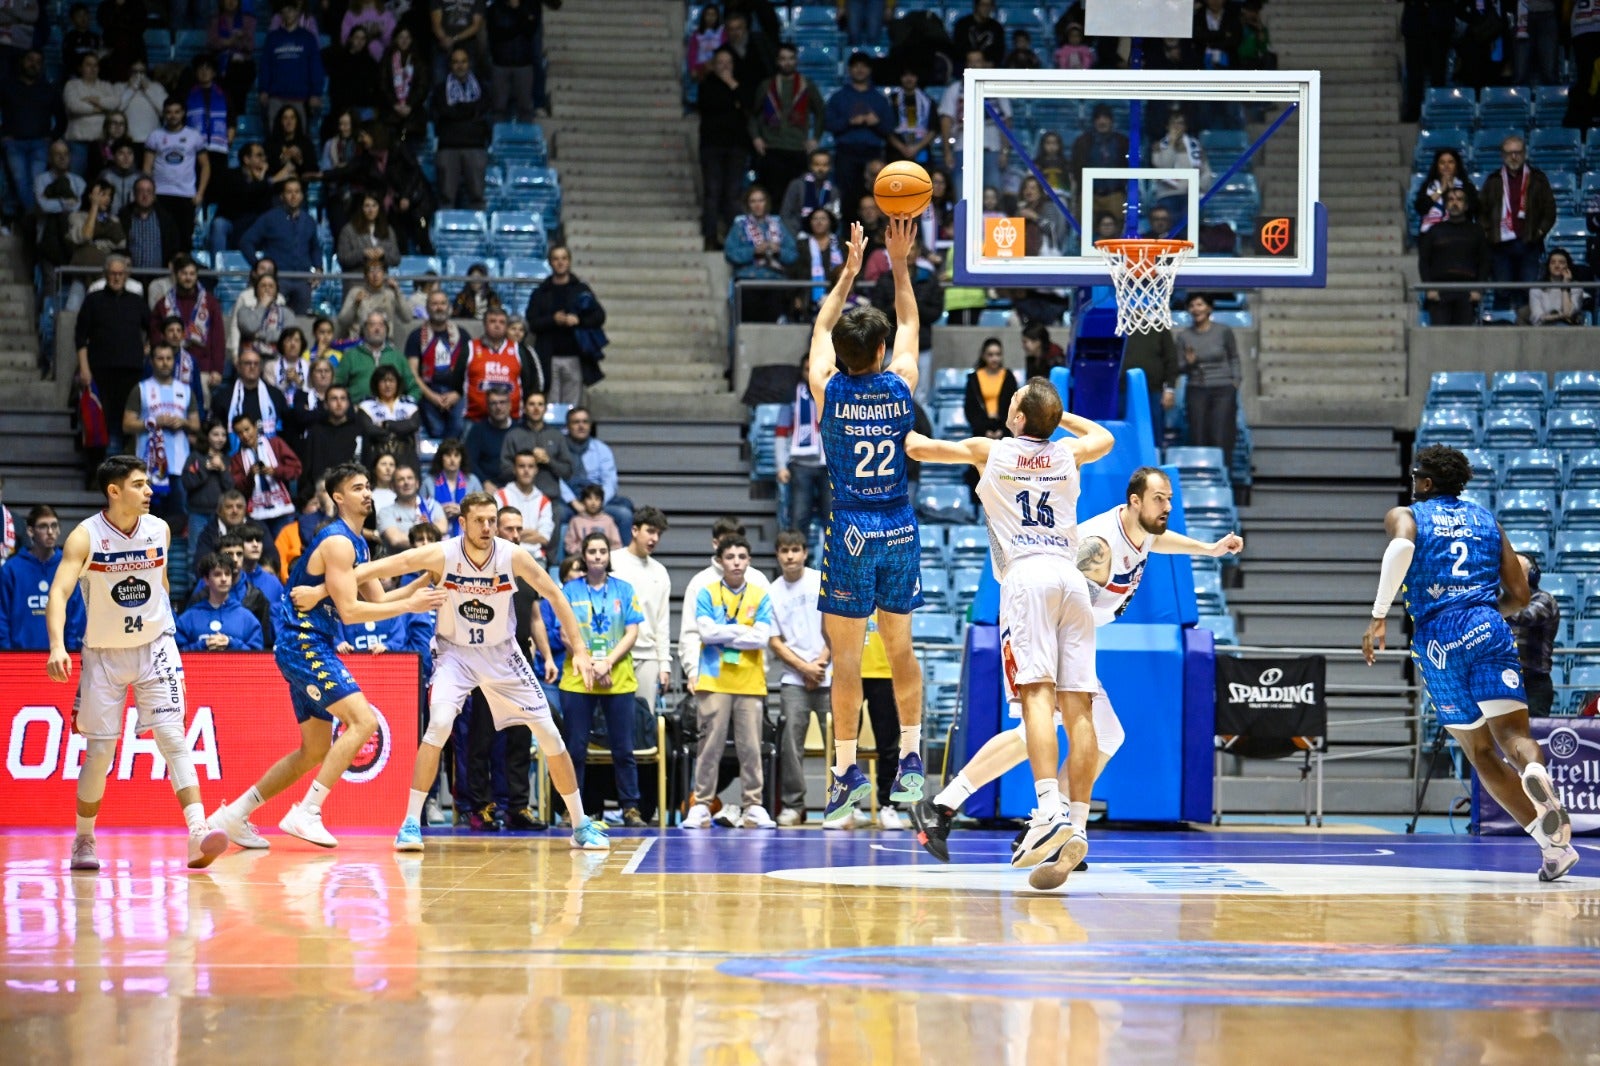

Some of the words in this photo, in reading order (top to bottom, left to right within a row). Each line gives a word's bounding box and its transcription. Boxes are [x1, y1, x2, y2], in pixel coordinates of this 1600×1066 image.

[835, 402, 901, 420] LANGARITA
[854, 439, 895, 478] 22
[1016, 490, 1055, 528] 16
[1432, 514, 1467, 527] NWEKE
[863, 531, 886, 539] URIA
[886, 524, 915, 538] MOTOR
[887, 535, 914, 547] OVIEDO
[105, 561, 156, 573] OBRADOIRO
[1450, 541, 1469, 577] 2
[117, 584, 146, 593] Estrella
[118, 591, 146, 601] Galicia
[124, 615, 143, 633] 24
[1461, 621, 1491, 643] MOTOR
[469, 628, 485, 645] 13
[1465, 631, 1491, 650] OVIEDO
[1228, 682, 1316, 705] SPALDING
